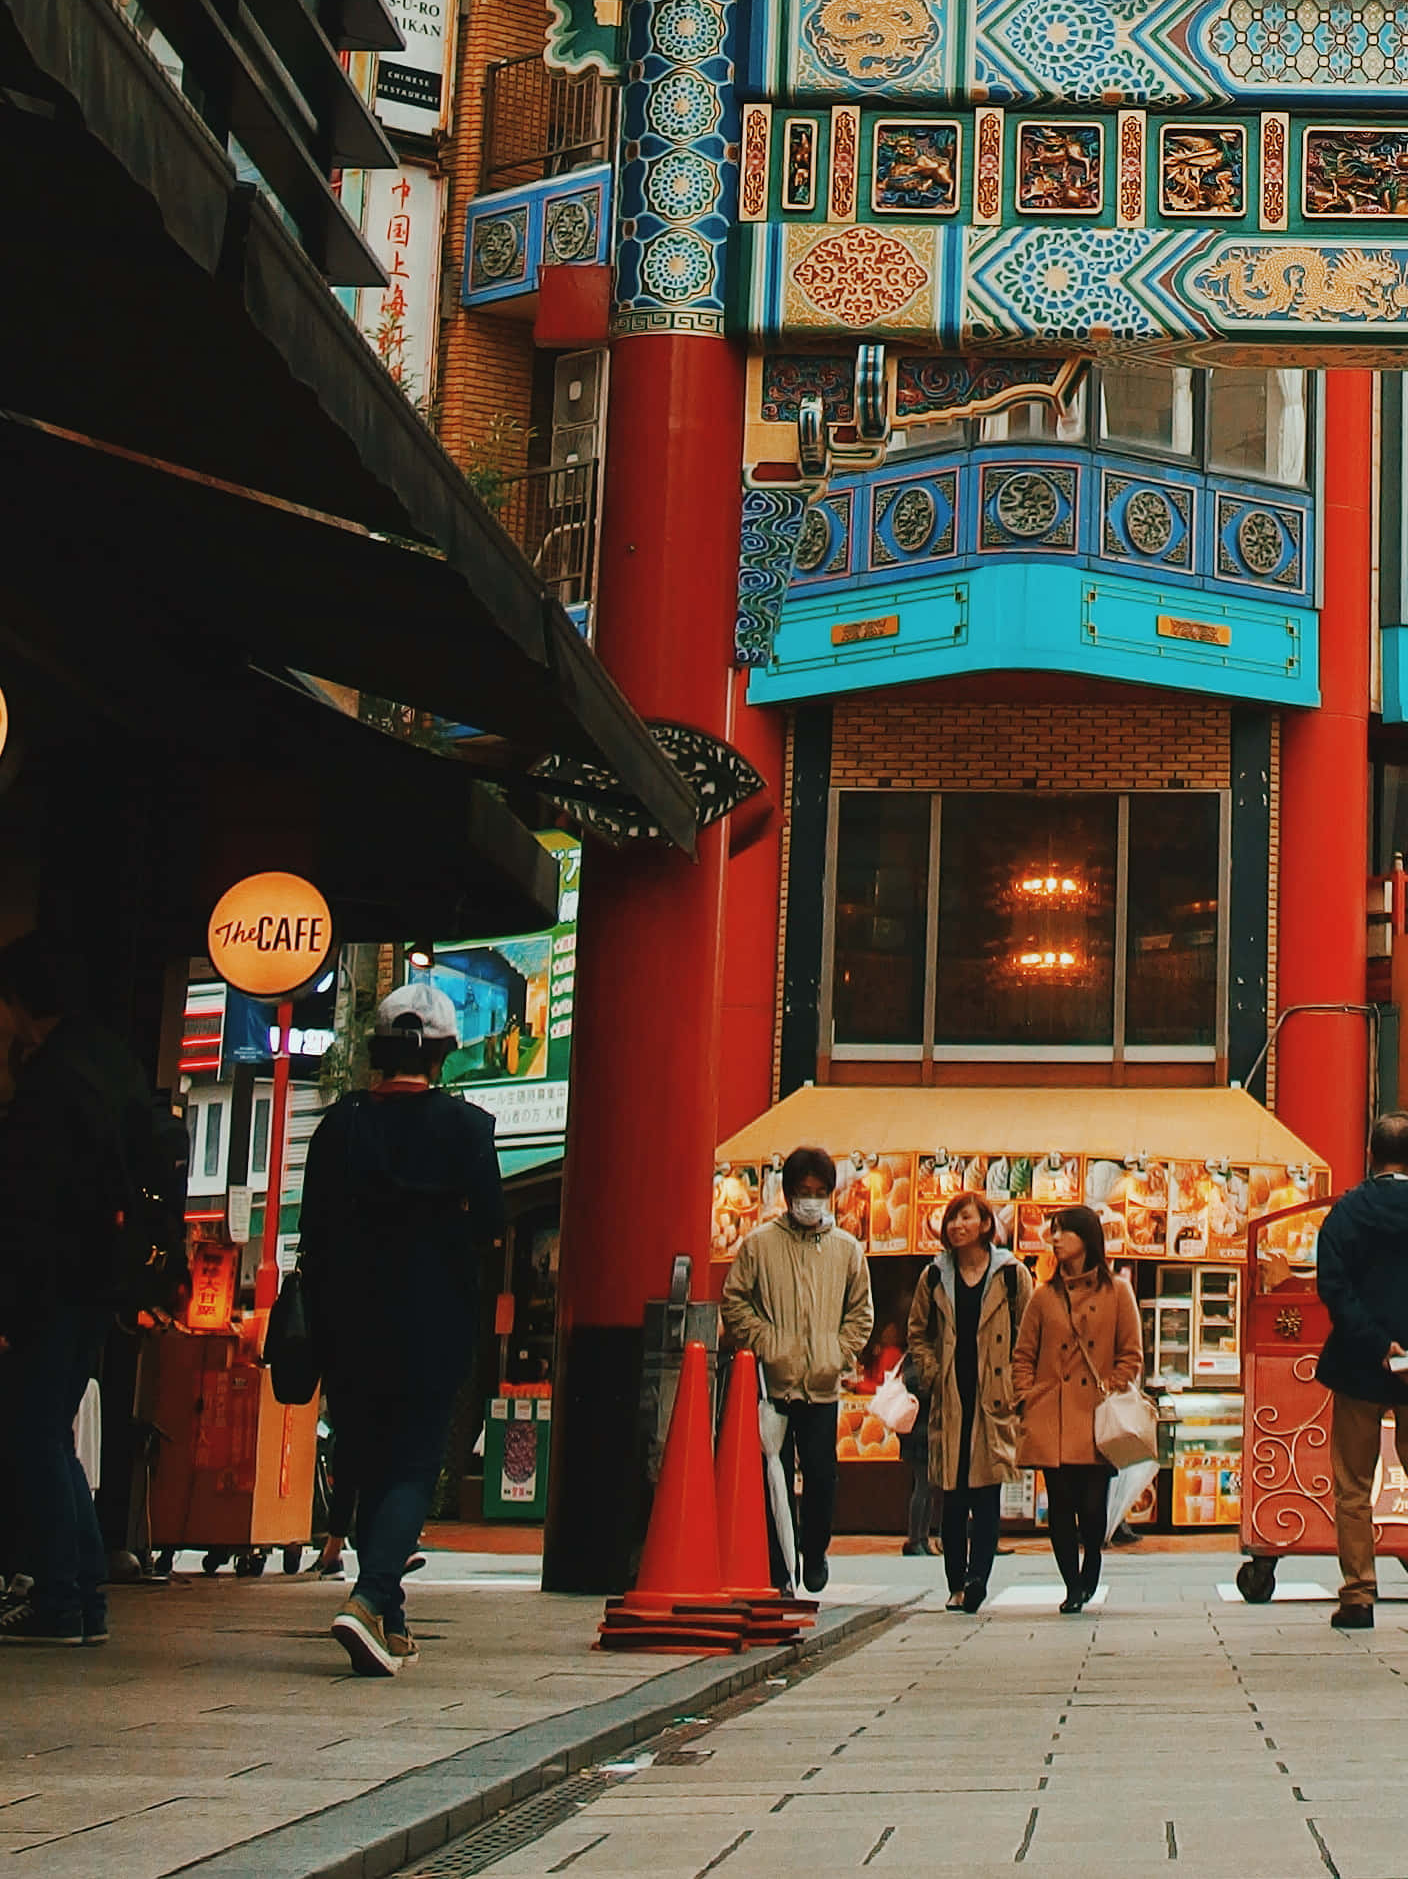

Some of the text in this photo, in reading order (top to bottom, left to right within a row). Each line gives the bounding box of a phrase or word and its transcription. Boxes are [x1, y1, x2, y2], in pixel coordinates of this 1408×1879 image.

[387, 71, 430, 87] CHINESE
[215, 916, 324, 953] The CAFE
